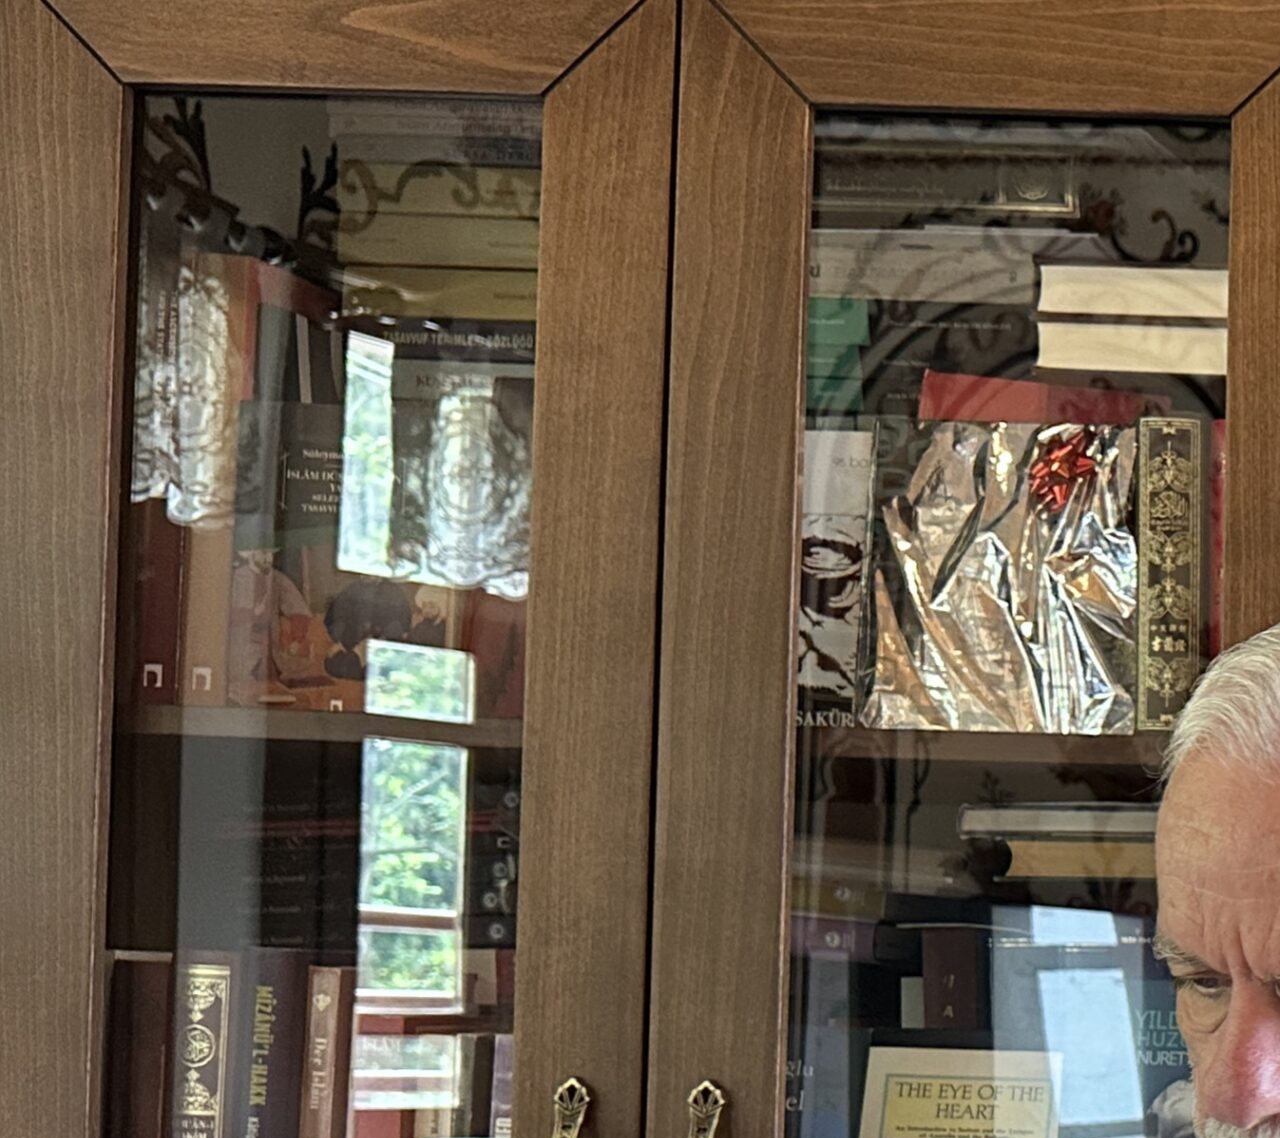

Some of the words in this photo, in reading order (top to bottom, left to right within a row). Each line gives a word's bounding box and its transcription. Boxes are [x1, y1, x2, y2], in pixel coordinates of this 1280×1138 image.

[895, 1081, 932, 1099] THE
[938, 1083, 973, 1101] EYE
[977, 1084, 1004, 1101] OF
[1006, 1085, 1045, 1103] THE
[935, 1103, 999, 1121] HEART
